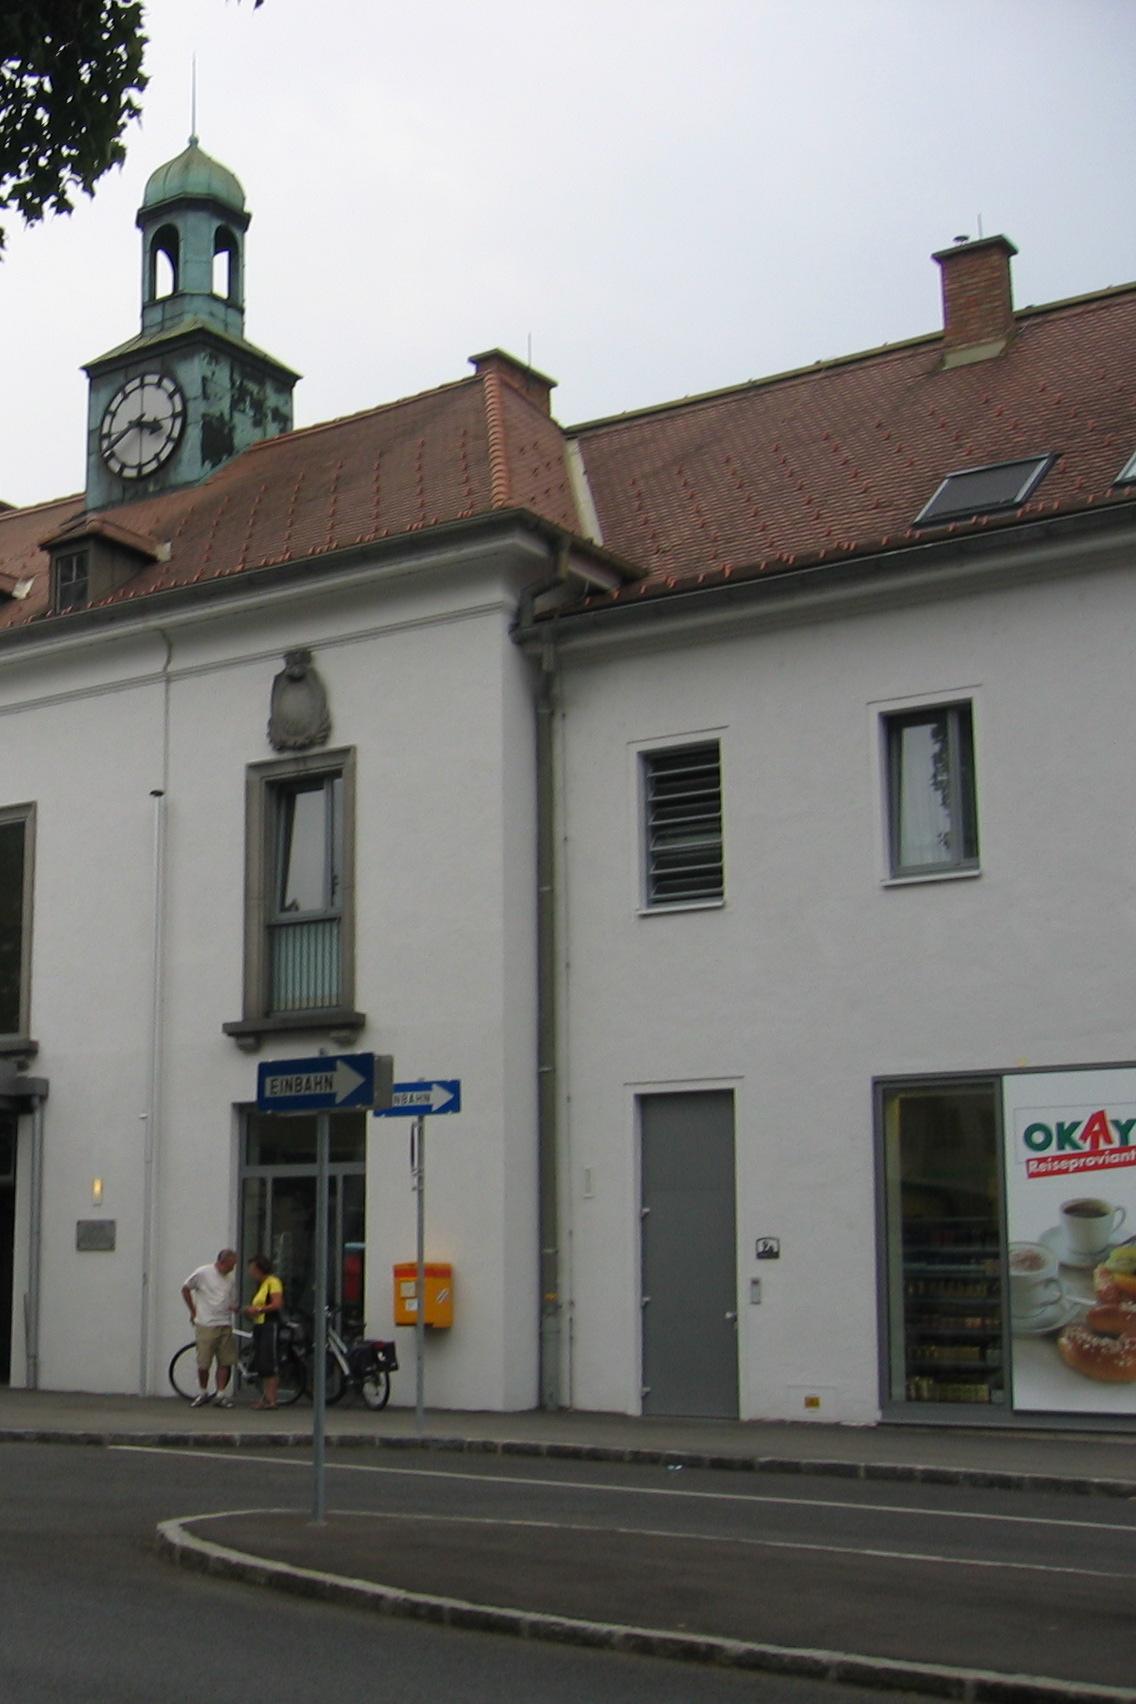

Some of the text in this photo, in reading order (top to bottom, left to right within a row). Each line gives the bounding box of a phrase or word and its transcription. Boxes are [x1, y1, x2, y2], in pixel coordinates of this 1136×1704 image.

[270, 1074, 333, 1095] EINBAHN
[394, 1092, 431, 1106] NBAHN
[1023, 1109, 1136, 1152] OKAY
[1028, 1150, 1136, 1173] Reiseproviant
